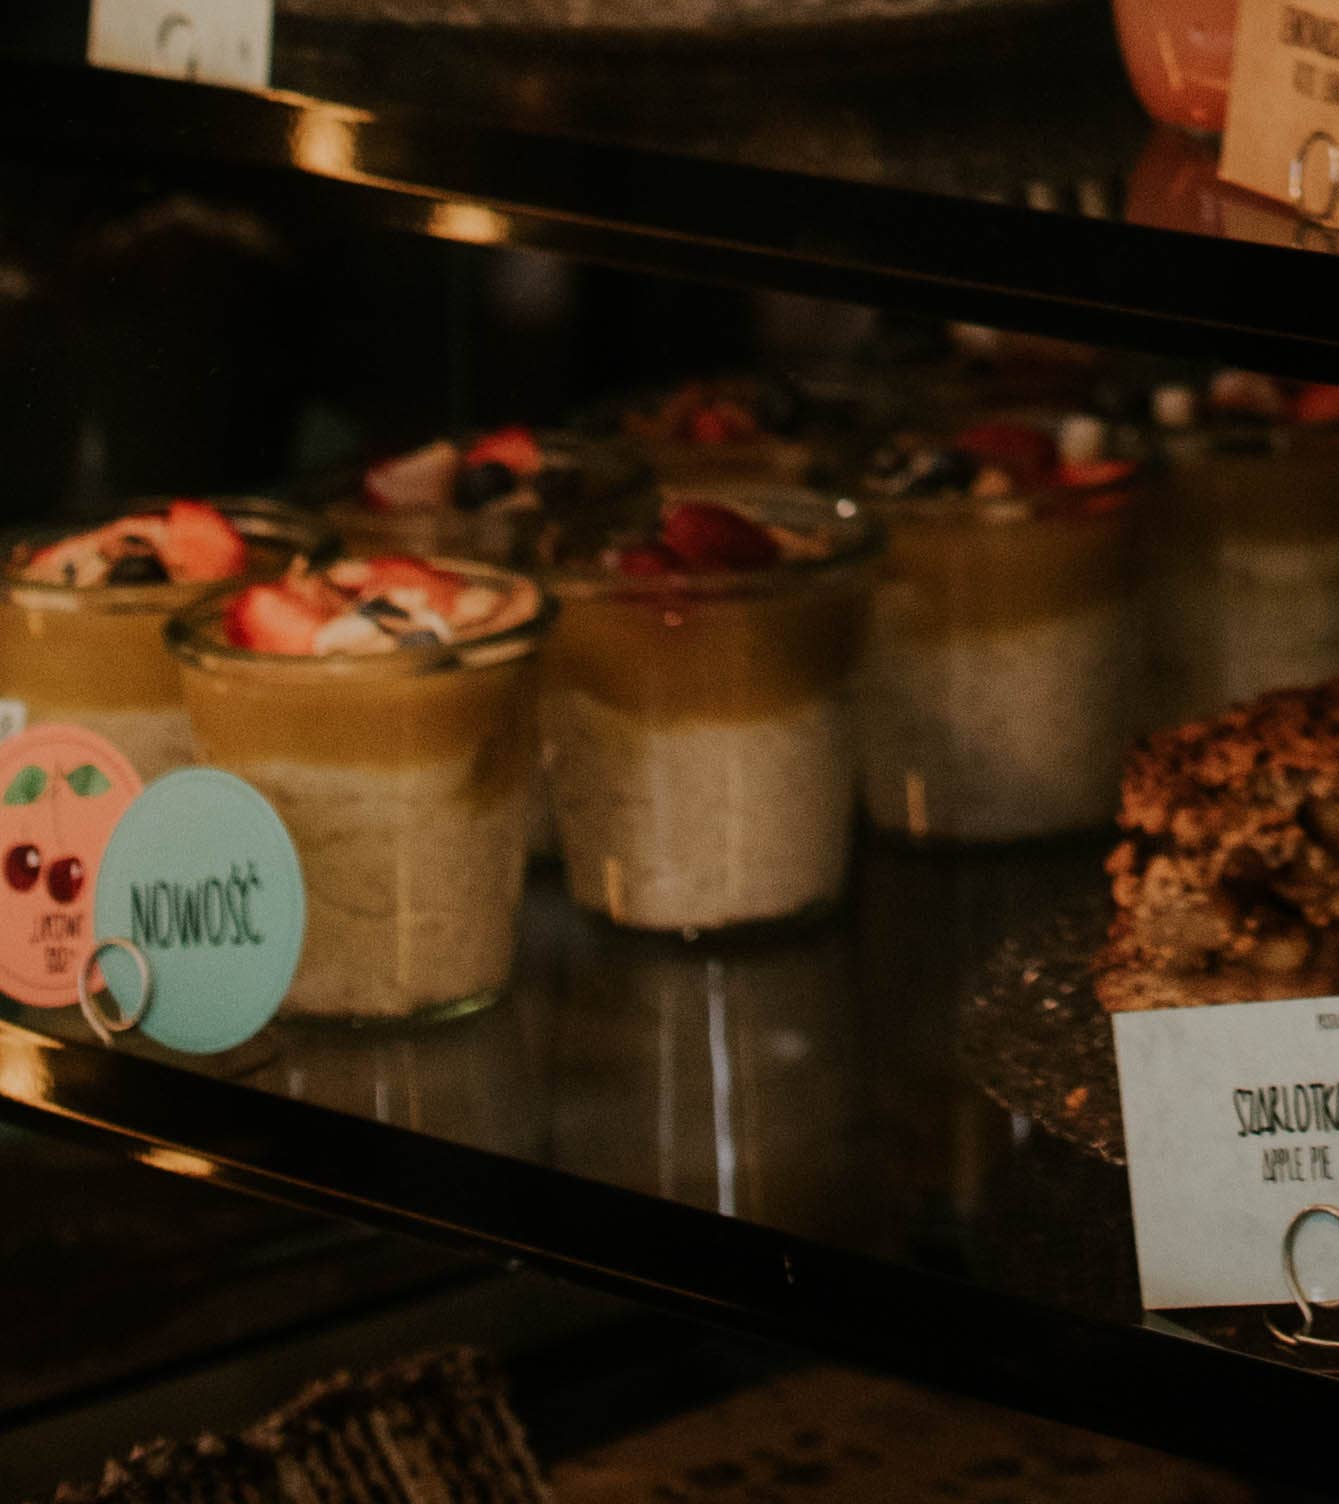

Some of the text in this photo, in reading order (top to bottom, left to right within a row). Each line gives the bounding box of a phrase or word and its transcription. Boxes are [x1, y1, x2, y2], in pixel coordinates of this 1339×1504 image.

[130, 859, 265, 949] NOWOŚĆ
[1262, 1145, 1334, 1182] APPLE PIE
